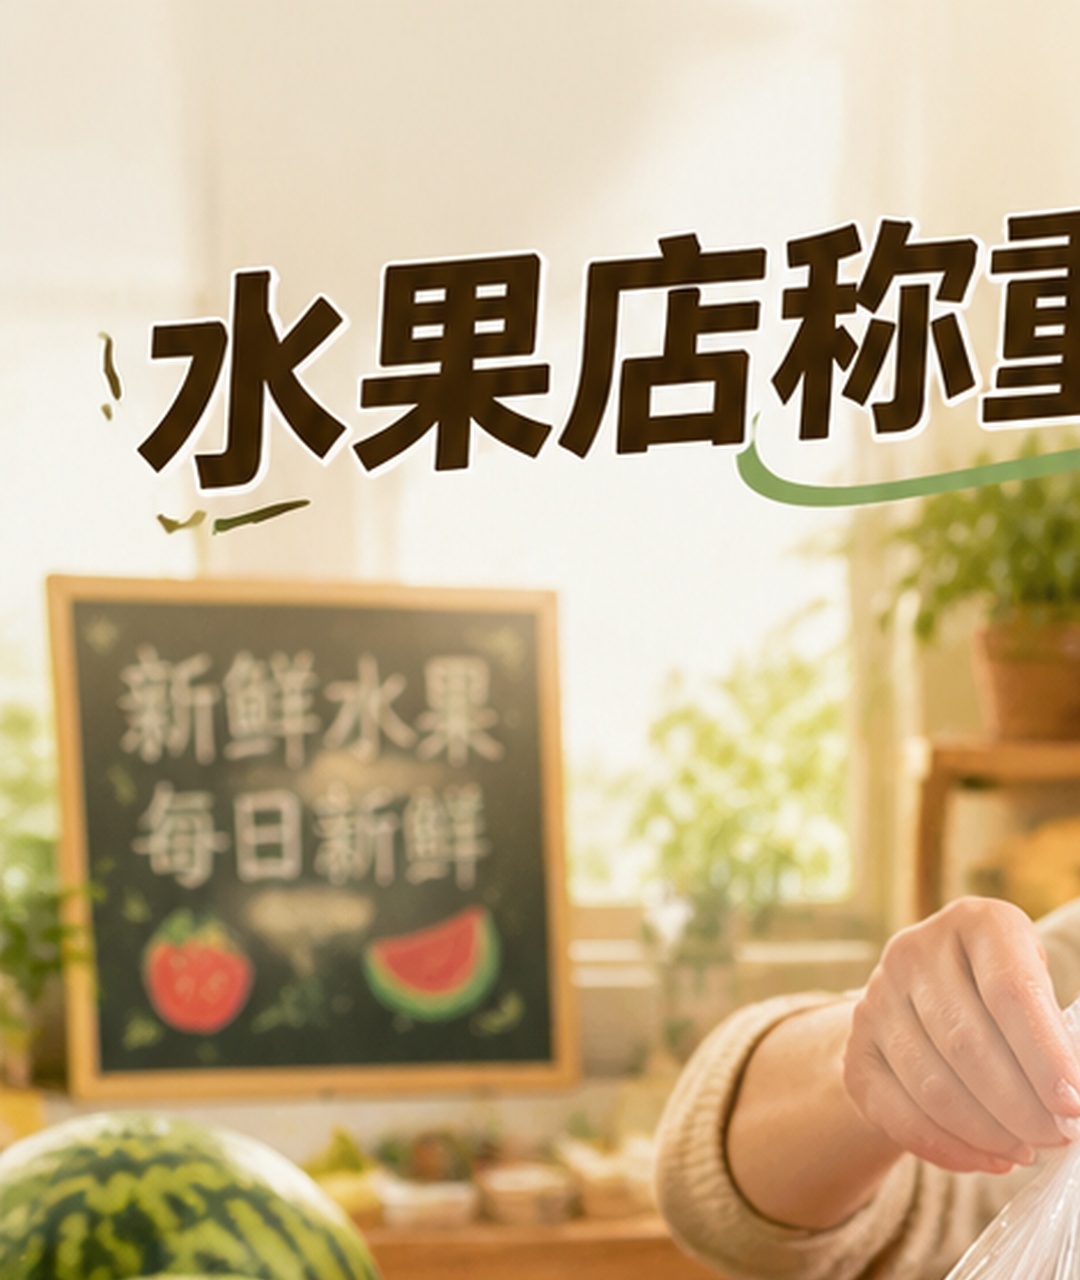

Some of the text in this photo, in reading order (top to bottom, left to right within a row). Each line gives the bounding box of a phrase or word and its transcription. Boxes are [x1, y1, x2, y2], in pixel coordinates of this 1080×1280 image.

[119, 643, 503, 769] 新鲜水果
[132, 781, 491, 889] 每日新鲜
